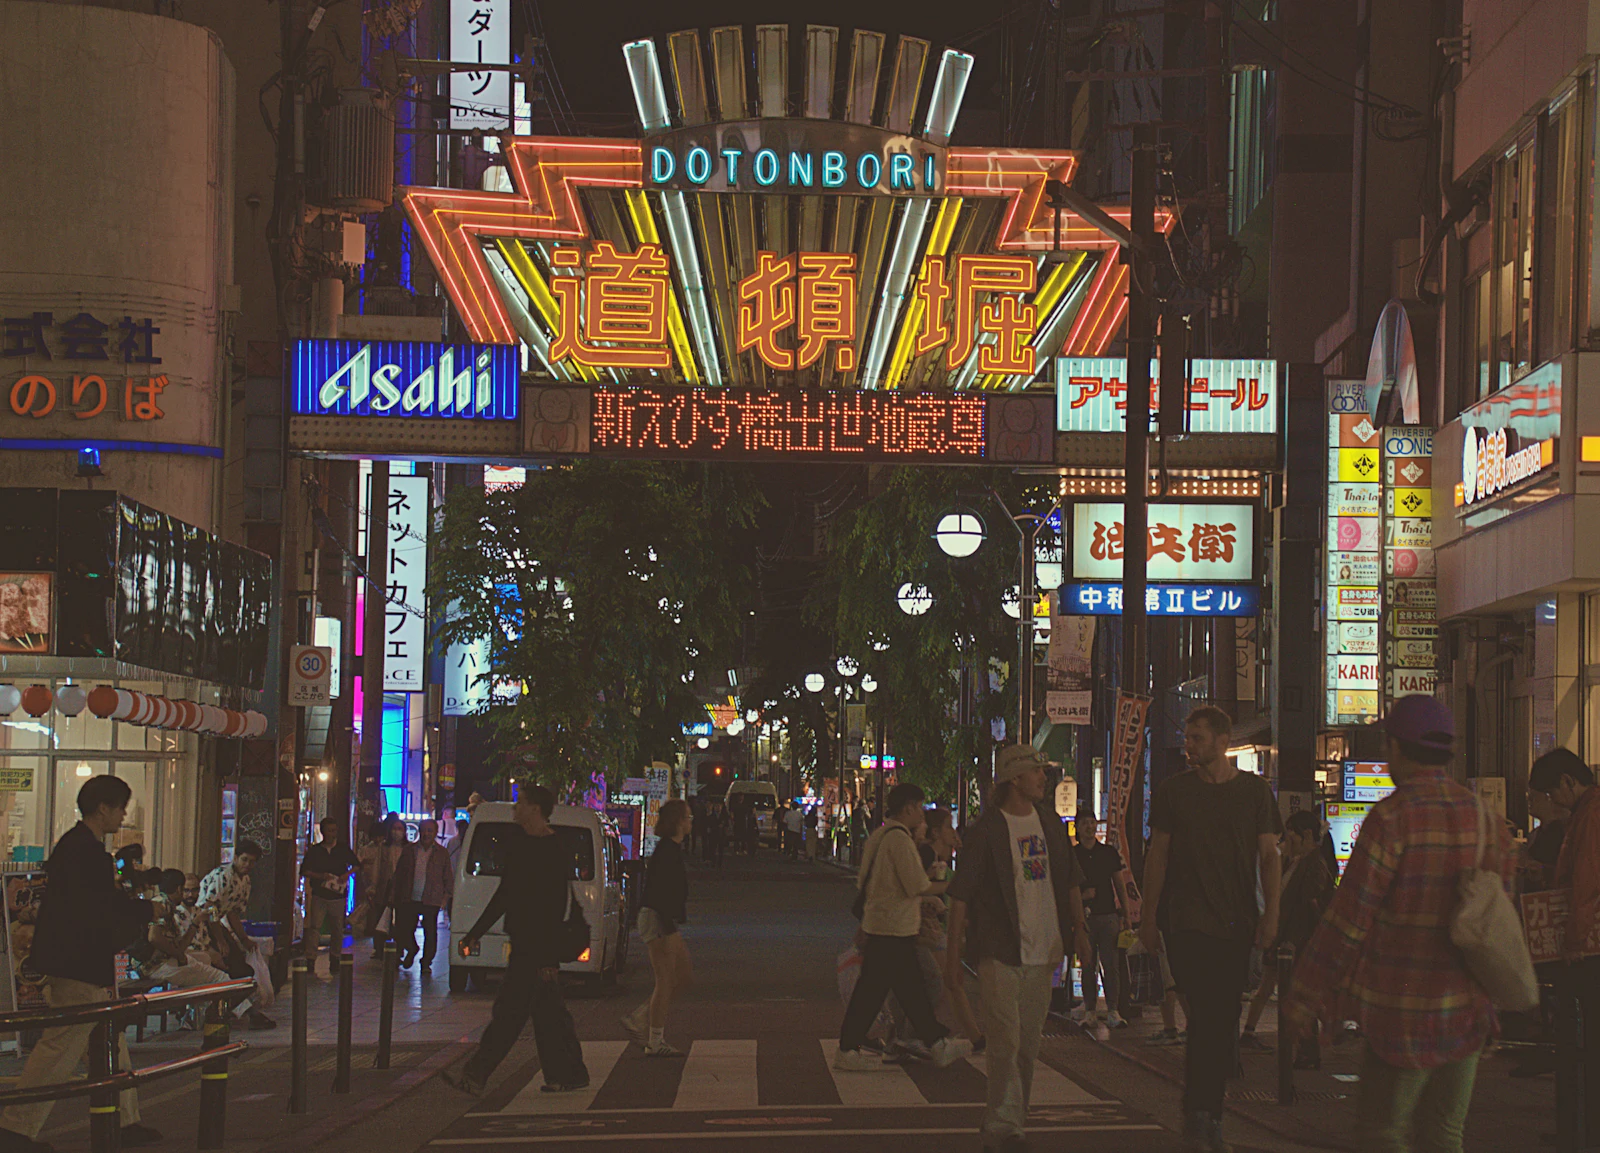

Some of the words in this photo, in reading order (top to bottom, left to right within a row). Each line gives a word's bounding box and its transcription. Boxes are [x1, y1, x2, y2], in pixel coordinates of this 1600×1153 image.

[467, 0, 494, 96] ダーツ
[652, 146, 936, 190] DOTONBORI
[549, 240, 1039, 375] 道頓堀
[1, 312, 162, 364] 式会社
[10, 374, 169, 420] のりば
[319, 344, 491, 413] Asahi
[1069, 376, 1269, 411] アサビール
[1336, 384, 1366, 395] RIVER
[1340, 506, 1378, 514] タイ古式マッサ
[302, 657, 320, 671] 30
[294, 692, 324, 700] ここから
